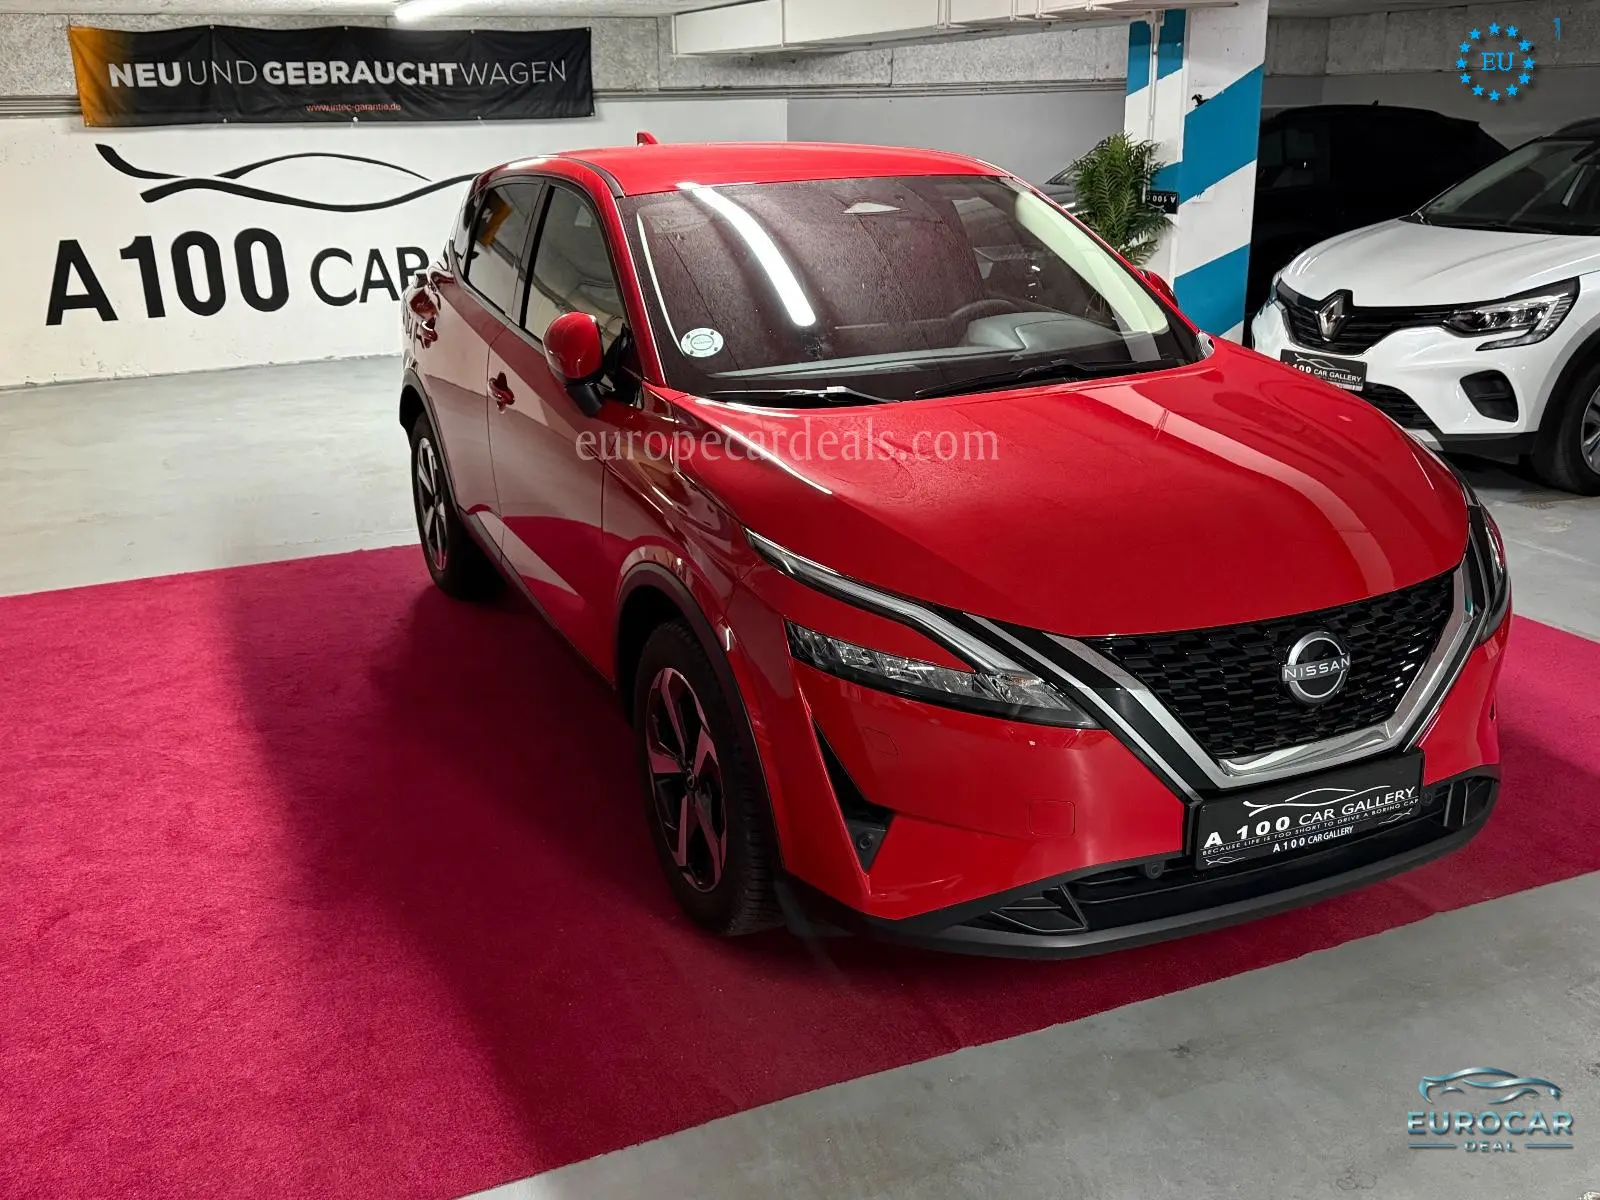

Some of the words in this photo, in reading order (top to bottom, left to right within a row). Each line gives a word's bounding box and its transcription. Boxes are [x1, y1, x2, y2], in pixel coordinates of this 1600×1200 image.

[108, 61, 182, 88] NEU
[187, 60, 257, 85] UND
[305, 102, 402, 112] www.intec-garantie.de
[45, 239, 119, 326] A
[119, 227, 290, 318] 100
[1313, 368, 1327, 377] CAR
[1329, 371, 1362, 383] GALLERY
[1284, 655, 1350, 679] NISSAN
[1202, 842, 1241, 856] BECAUSE
[1244, 838, 1260, 846] LIFE
[1274, 831, 1292, 839] TOO
[1295, 824, 1320, 835] SHORT
[1337, 815, 1360, 824] DRIVE
[1371, 804, 1401, 816] BORING
[1203, 831, 1223, 849] A
[1236, 816, 1290, 840] 100
[1299, 808, 1335, 825] CAR
[1341, 786, 1416, 815] GALLERY
[1272, 843, 1281, 853] A
[1307, 833, 1323, 844] CAR
[1323, 825, 1354, 840] GALLERY
